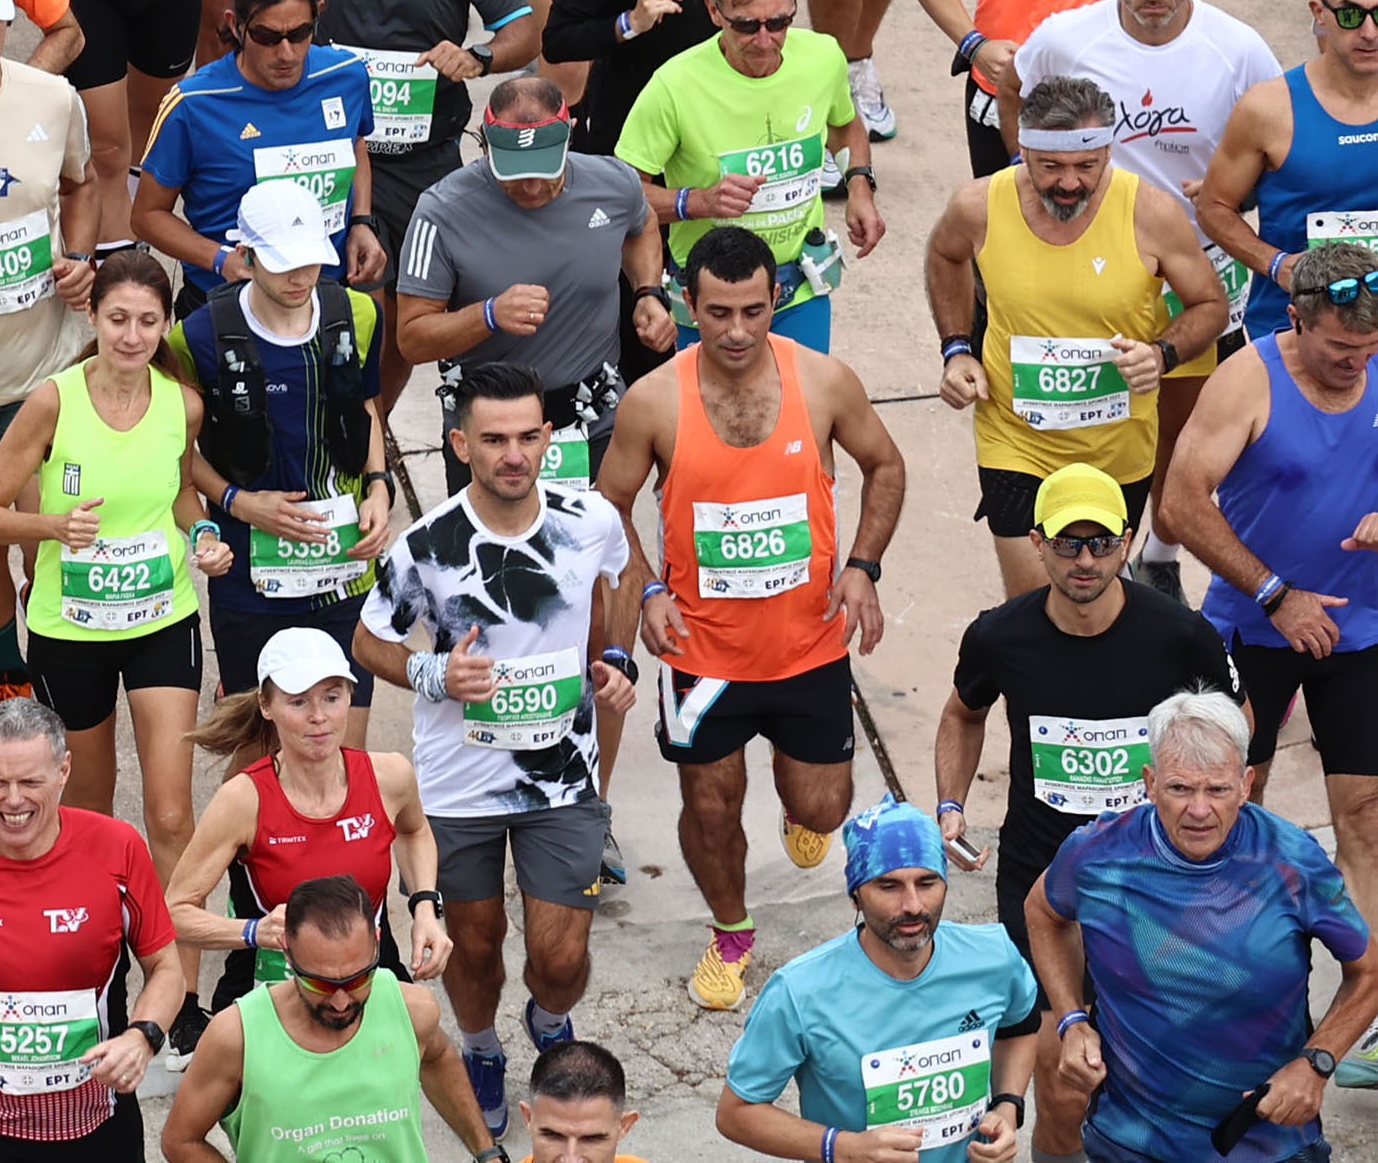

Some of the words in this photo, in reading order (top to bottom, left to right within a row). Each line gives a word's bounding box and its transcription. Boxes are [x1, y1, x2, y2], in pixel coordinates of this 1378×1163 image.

[1338, 134, 1378, 144] saucon
[746, 146, 805, 177] 6216
[1038, 365, 1101, 392] 6827
[720, 531, 784, 559] 6826
[88, 564, 150, 592] 6422
[491, 685, 556, 713] 6590
[1061, 749, 1129, 775] 6302
[1, 1025, 67, 1052] 5257
[897, 1072, 965, 1106] 5780
[270, 1122, 338, 1143] Organ
[343, 1105, 408, 1128] Donation
